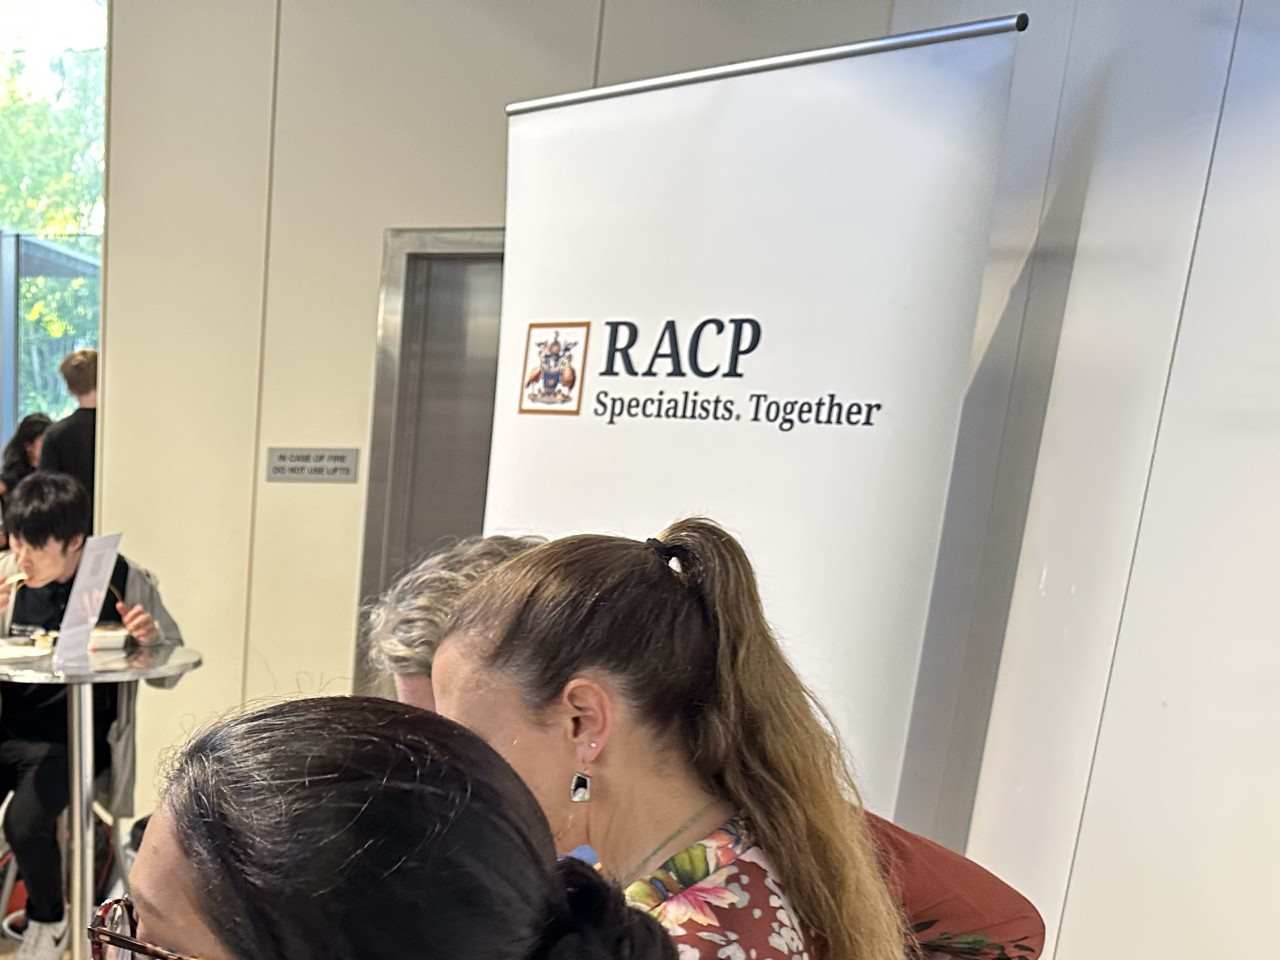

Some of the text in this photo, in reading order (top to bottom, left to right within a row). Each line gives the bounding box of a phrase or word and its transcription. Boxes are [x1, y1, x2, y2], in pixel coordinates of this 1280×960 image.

[599, 318, 762, 378] RACP
[593, 390, 882, 432] Specialists. Together
